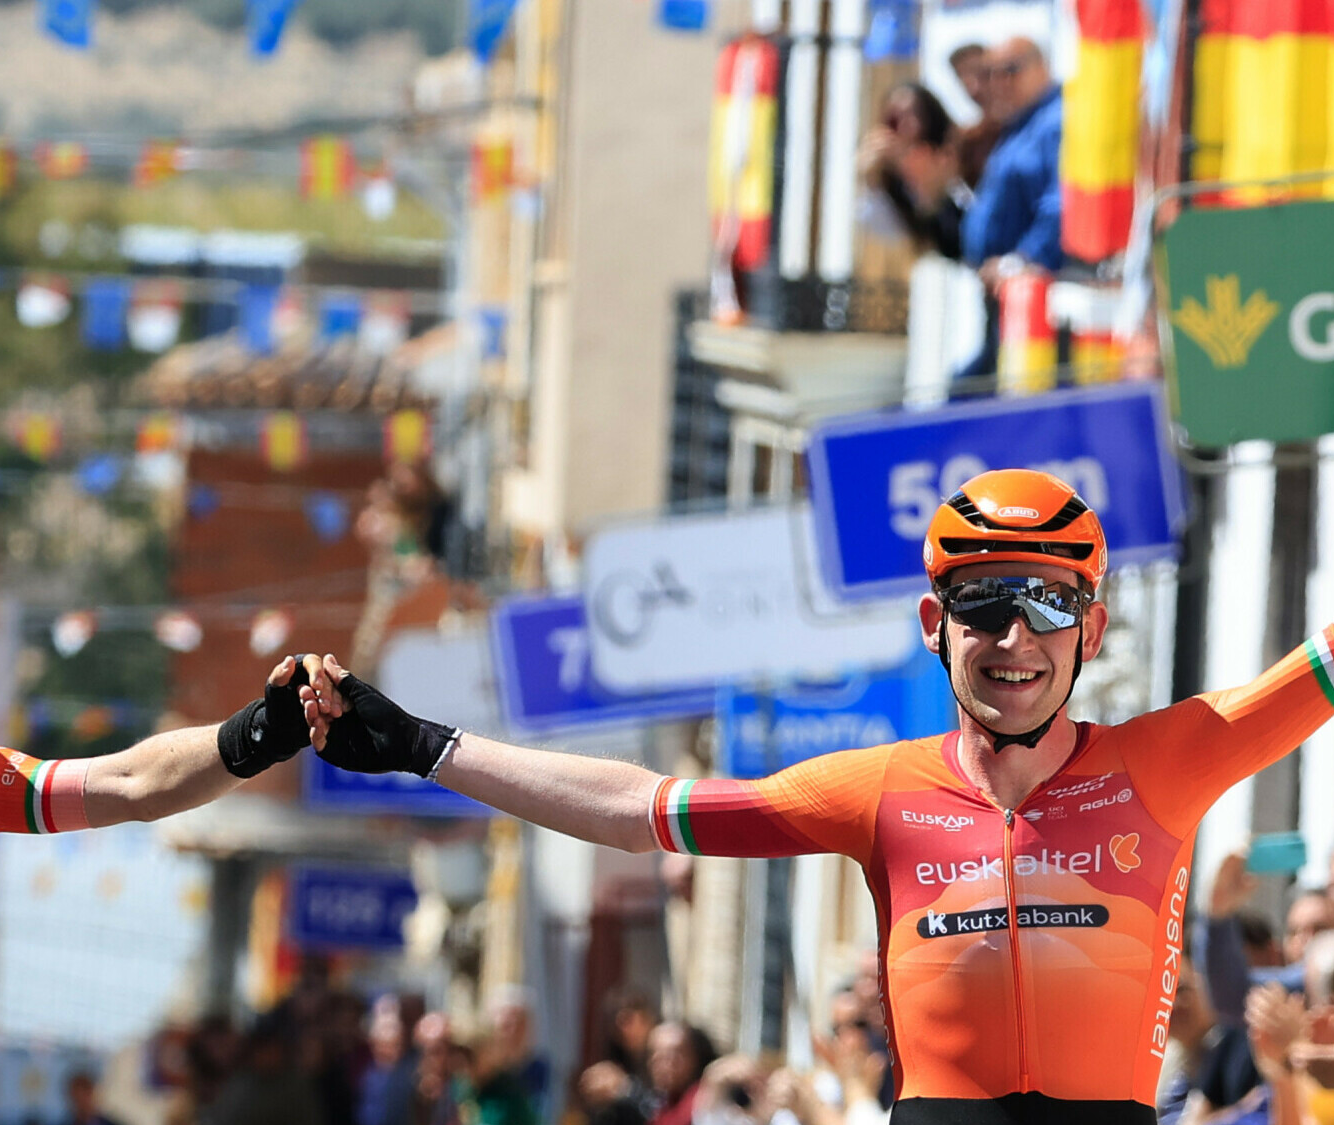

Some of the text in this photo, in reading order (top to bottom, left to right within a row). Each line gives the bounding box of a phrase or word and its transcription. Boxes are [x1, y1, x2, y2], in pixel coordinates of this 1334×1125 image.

[1002, 508, 1035, 518] ABUS
[1047, 771, 1114, 795] QUICK
[915, 844, 1102, 886] euskaltel
[957, 908, 1095, 932] kutxabank
[1150, 866, 1188, 1059] euskaltel
